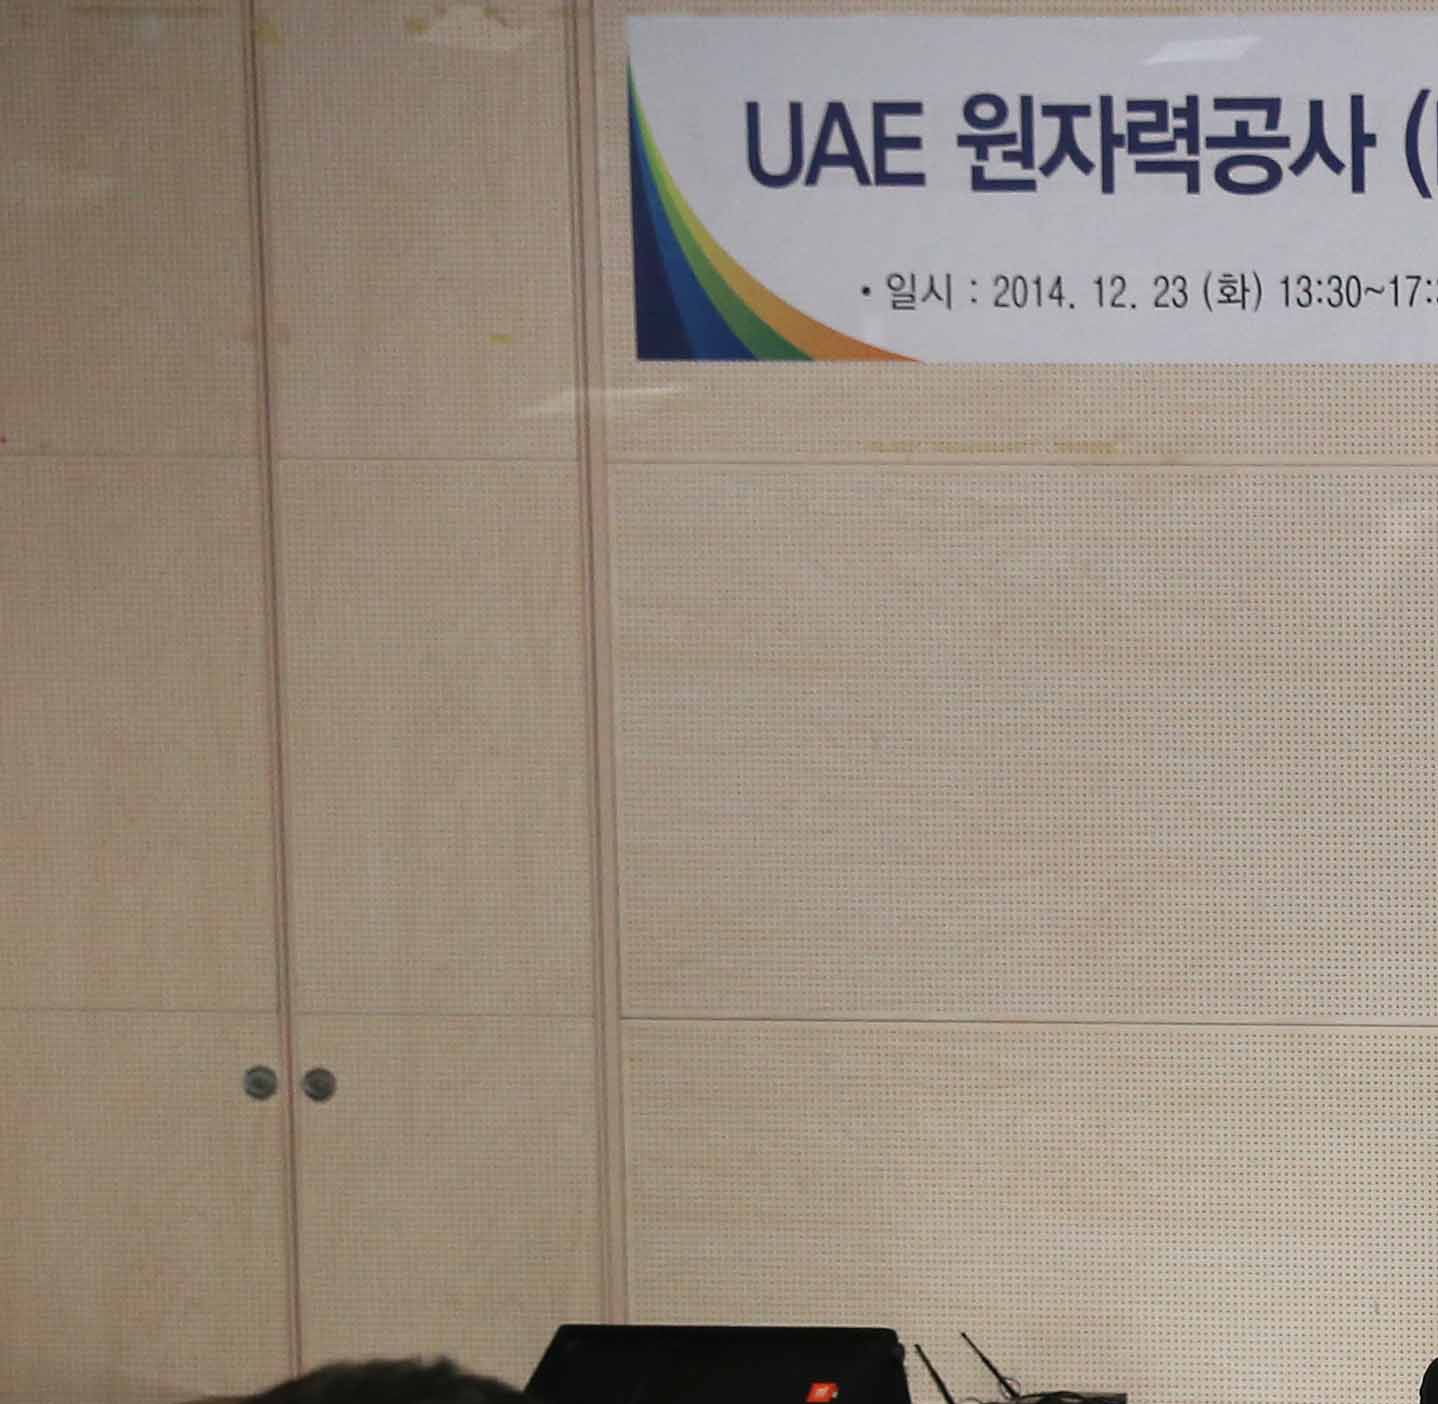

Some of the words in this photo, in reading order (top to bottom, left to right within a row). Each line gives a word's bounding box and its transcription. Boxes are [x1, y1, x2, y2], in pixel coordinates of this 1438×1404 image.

[743, 100, 927, 190] UAE
[956, 92, 1378, 196] 원자력공사
[885, 272, 952, 311] 일시
[993, 273, 1076, 310] 2014.
[1093, 274, 1137, 310] 12.
[1153, 274, 1189, 309] 23
[1202, 271, 1263, 313] (화)
